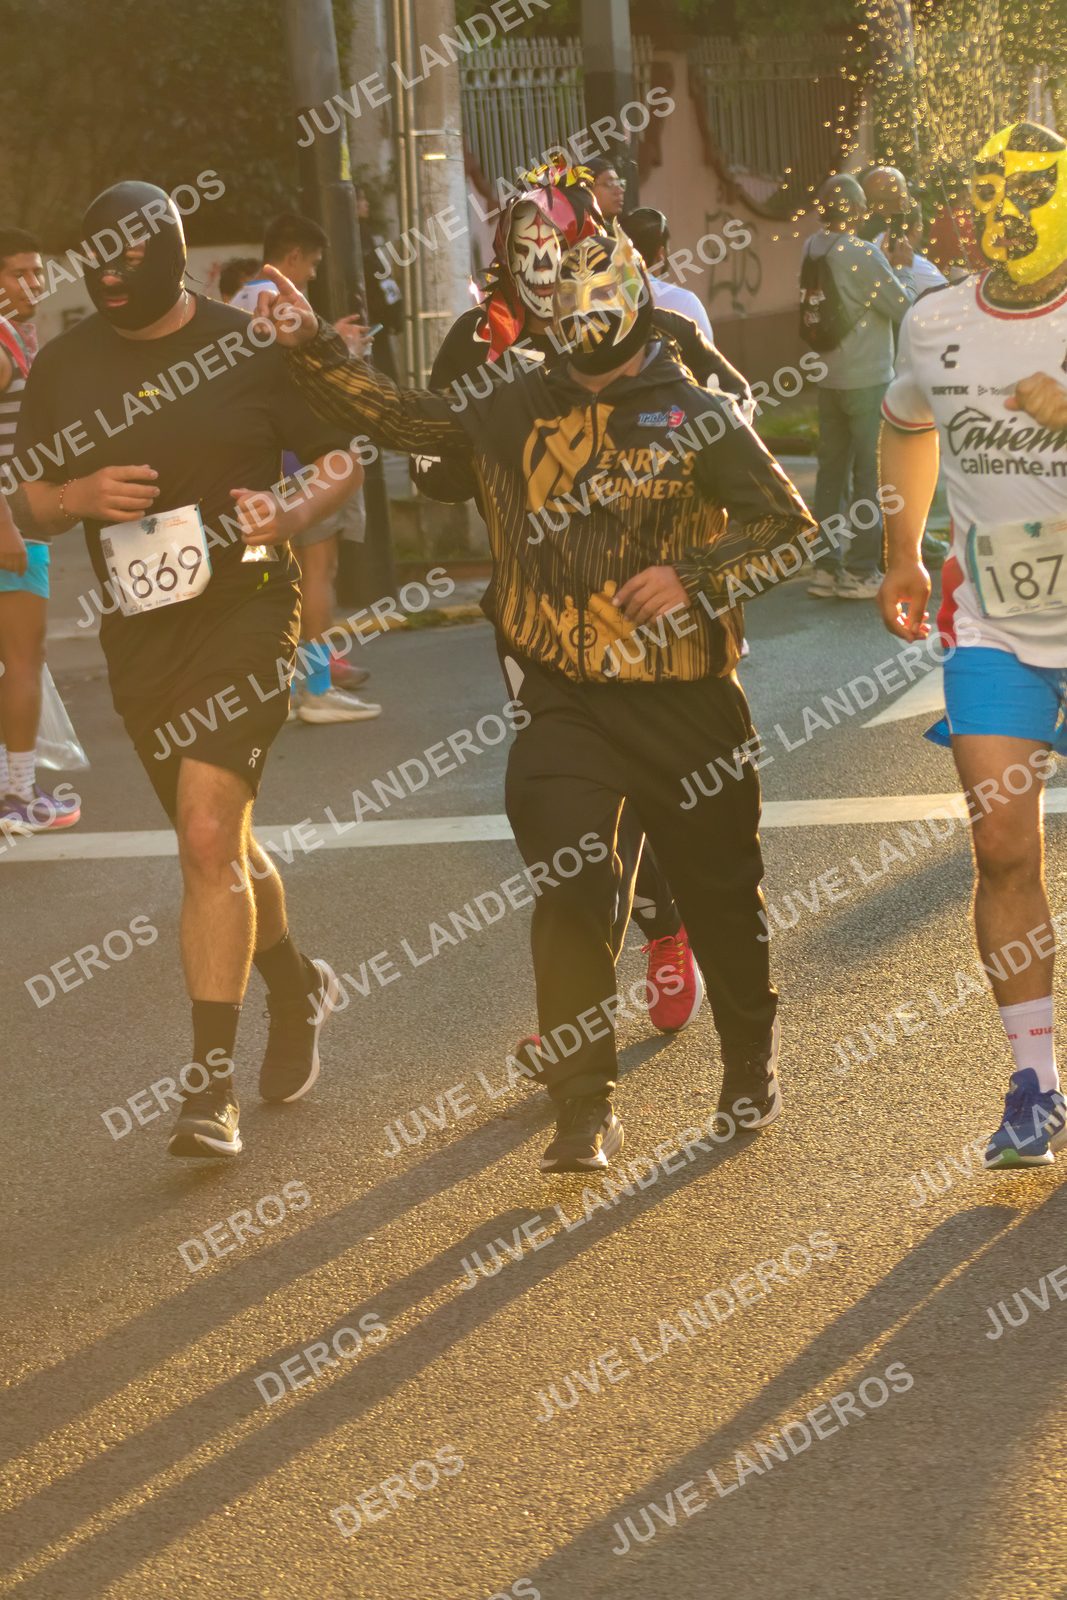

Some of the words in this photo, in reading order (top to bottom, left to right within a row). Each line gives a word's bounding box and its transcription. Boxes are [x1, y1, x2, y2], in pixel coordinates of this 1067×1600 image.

[139, 389, 160, 398] BOSS
[111, 546, 202, 604] 1869
[985, 553, 1064, 603] 187
